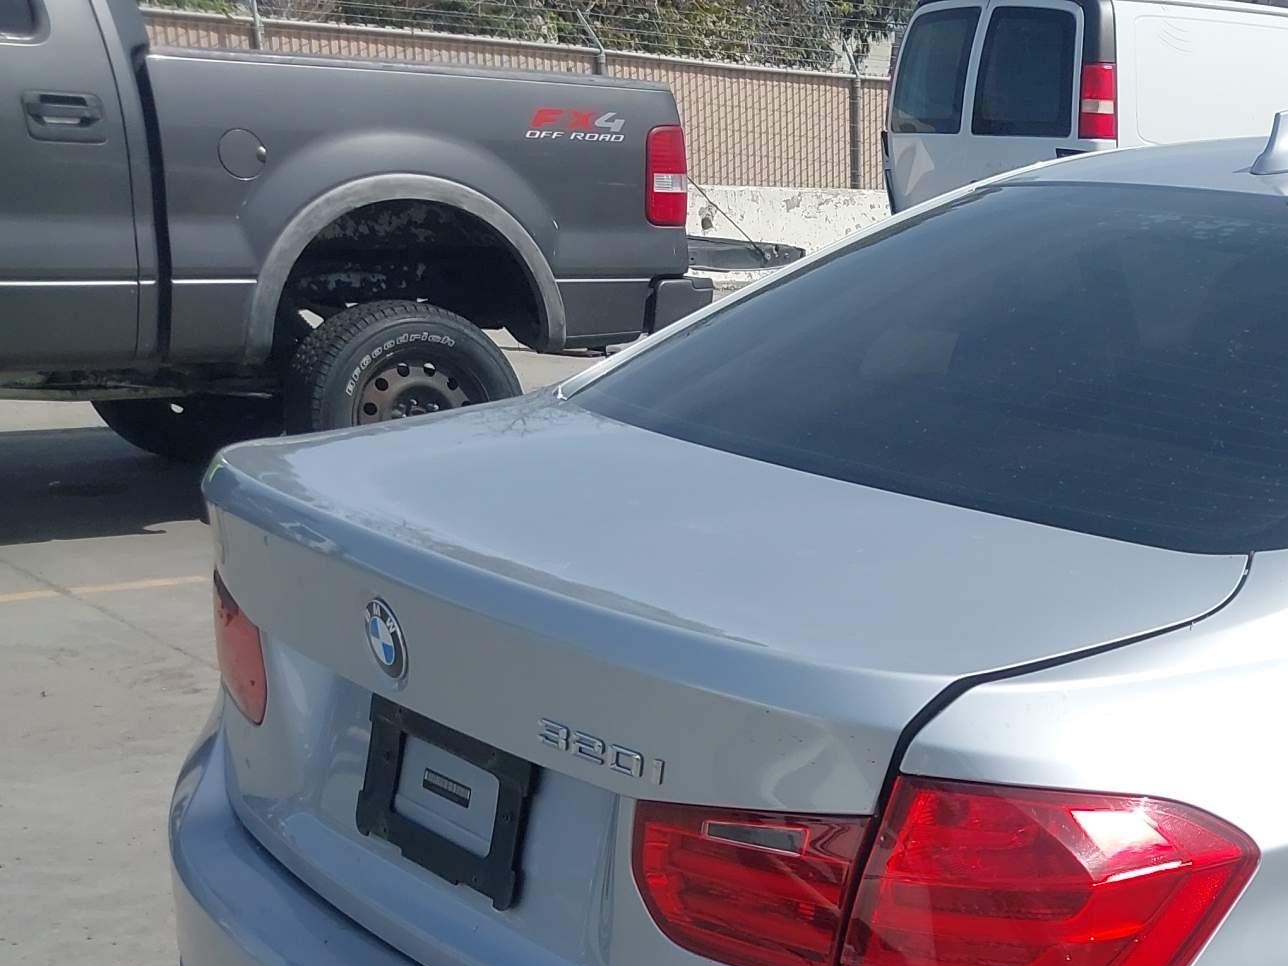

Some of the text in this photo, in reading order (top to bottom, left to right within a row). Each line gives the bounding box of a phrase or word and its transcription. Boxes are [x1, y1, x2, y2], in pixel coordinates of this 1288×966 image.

[530, 108, 625, 132] FX4
[525, 129, 625, 142] OFF ROAD
